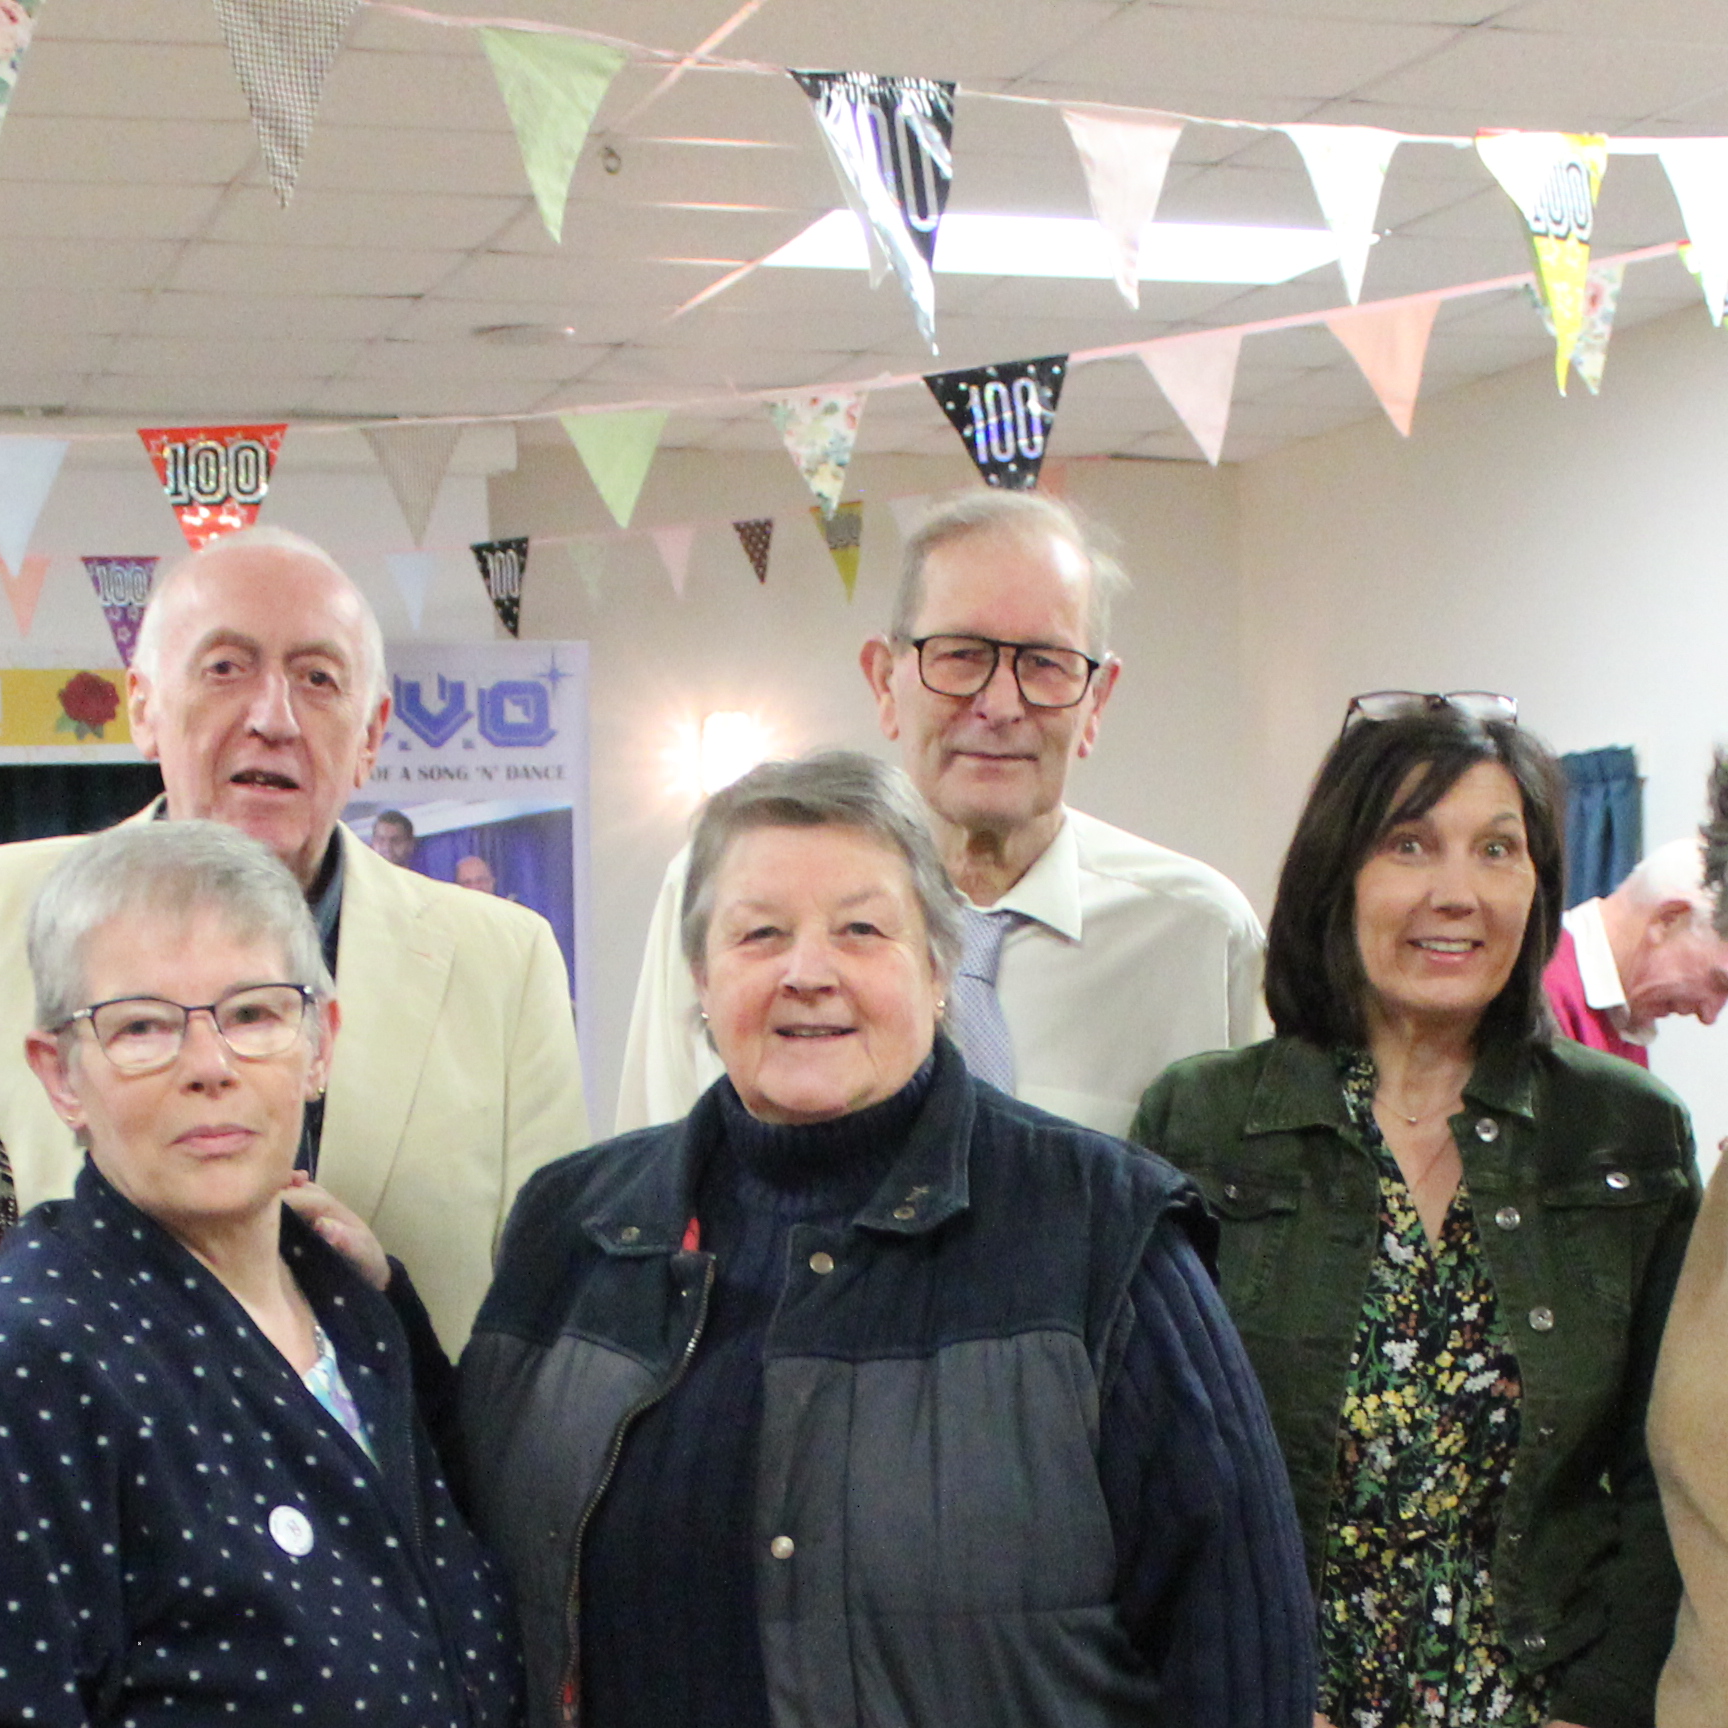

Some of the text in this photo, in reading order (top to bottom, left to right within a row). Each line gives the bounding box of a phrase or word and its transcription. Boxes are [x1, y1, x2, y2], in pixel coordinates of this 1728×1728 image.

[968, 377, 1045, 463] 100
[162, 438, 270, 505] 100
[93, 564, 151, 607] 100
[482, 549, 520, 600] 100
[400, 765, 412, 781] A
[417, 765, 469, 781] SONG
[505, 764, 566, 781] DANCE
